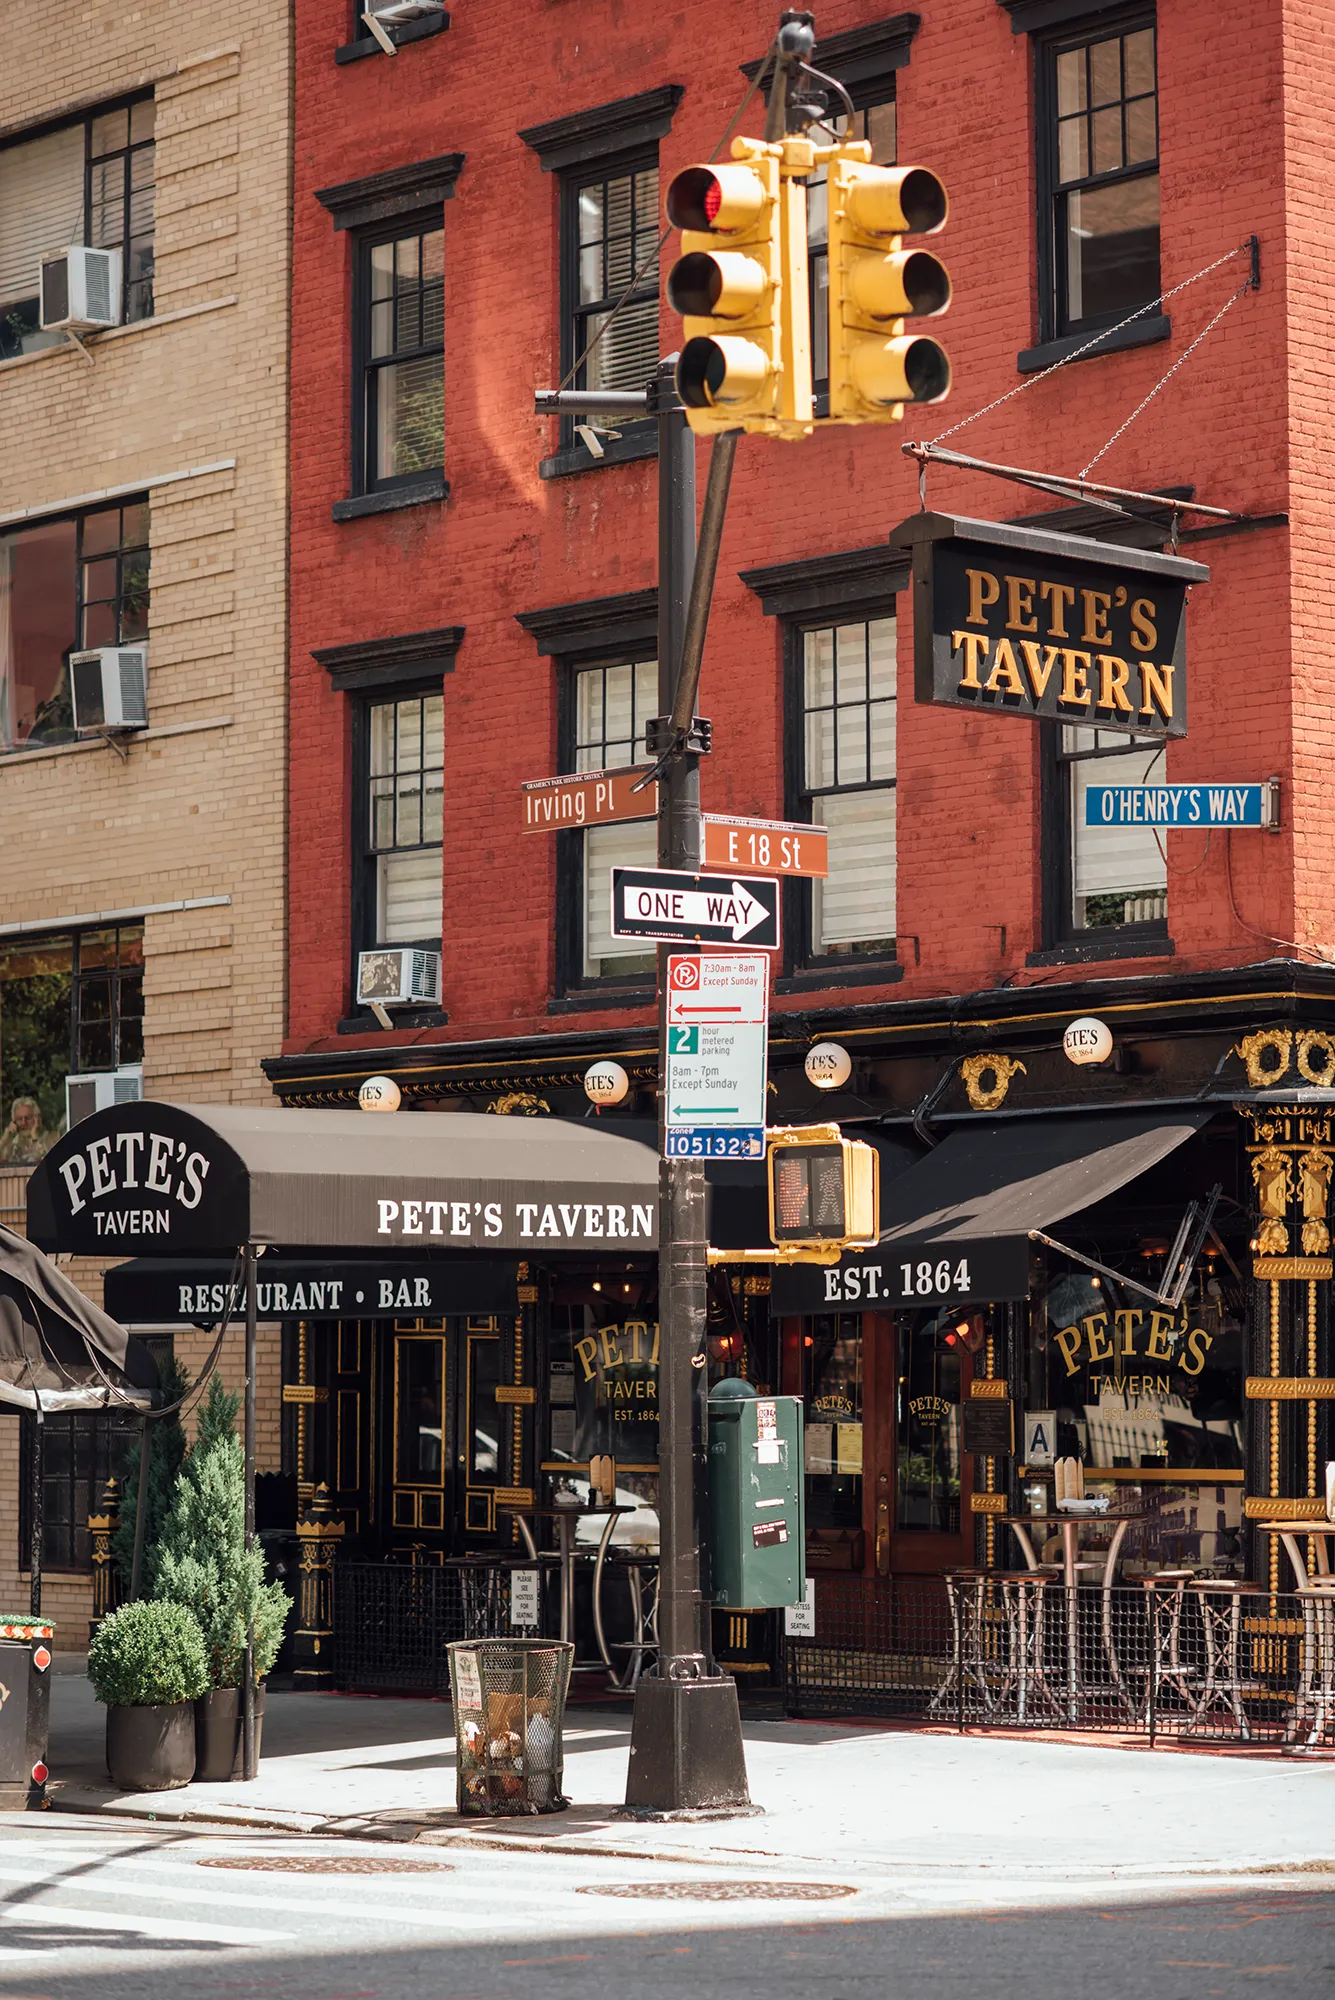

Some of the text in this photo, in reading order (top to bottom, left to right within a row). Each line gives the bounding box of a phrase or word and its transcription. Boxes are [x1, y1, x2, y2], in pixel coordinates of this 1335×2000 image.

[965, 568, 1158, 652] PETE'S
[952, 630, 1175, 717] TAVERN
[526, 772, 604, 790] GRAMERCY PARK HISTORIC DISTRICT
[527, 779, 614, 824] Irving Pl
[1101, 789, 1249, 822] O'HENRY'S WAY
[729, 831, 801, 869] E 18 St
[638, 891, 753, 925] ONE WAY
[704, 964, 732, 973] 7:30am
[738, 964, 756, 972] 8am
[703, 976, 758, 987] Except Sunday
[676, 1025, 691, 1052] 2
[702, 1027, 720, 1035] hour
[702, 1036, 735, 1045] metered
[1065, 1029, 1098, 1048] ETE'S
[702, 1046, 730, 1056] parking
[672, 1066, 692, 1076] 8am
[701, 1066, 719, 1077] 7pm
[585, 1075, 614, 1091] ETE'S
[672, 1078, 738, 1090] Except Sunday
[669, 1136, 740, 1155] 105132
[58, 1132, 210, 1215] PETE'S
[93, 1209, 170, 1235] TAVERN
[377, 1199, 654, 1237] PETE'S TAVERN
[823, 1258, 971, 1302] EST. 1864
[378, 1277, 432, 1308] BAR
[574, 1321, 660, 1383] PET
[1053, 1309, 1213, 1378] PETE'S
[603, 1380, 657, 1399] TAVER
[1089, 1375, 1170, 1395] TAVERN
[815, 1396, 854, 1413] PETE'S
[908, 1396, 951, 1415] PETE'S
[614, 1409, 635, 1421] EST.
[1103, 1408, 1160, 1422] EST. 1864
[1030, 1423, 1049, 1452] A
